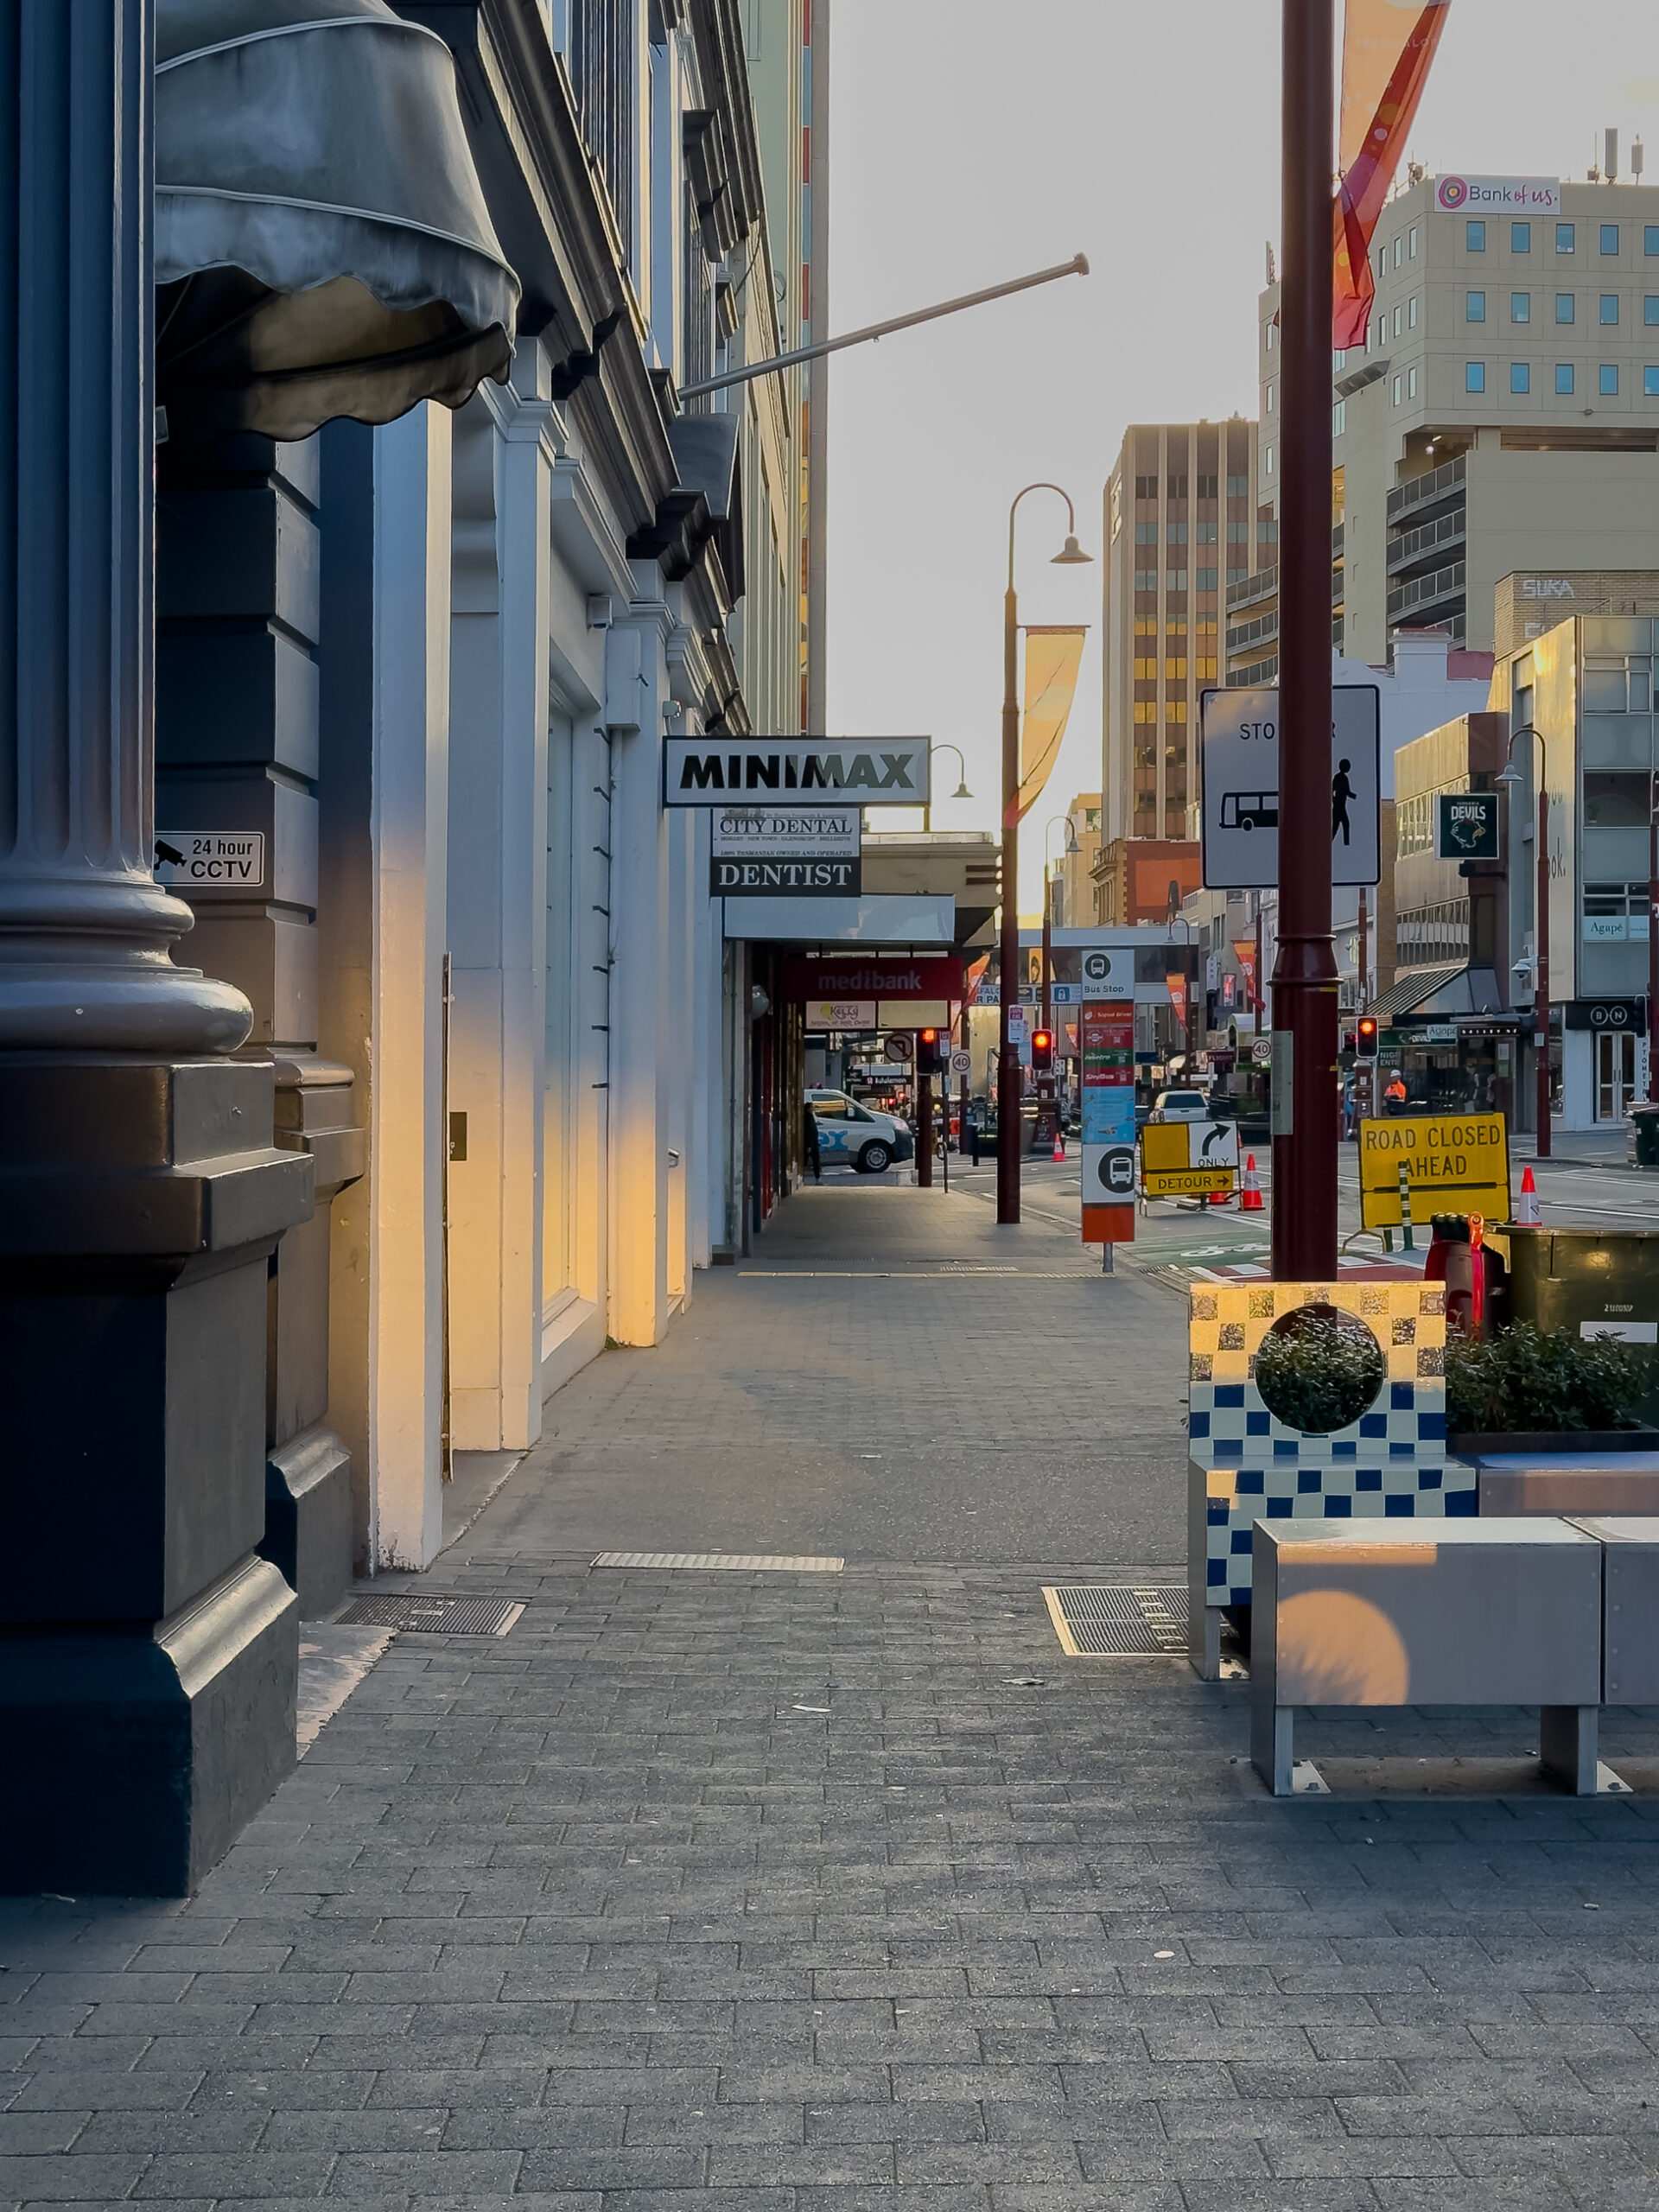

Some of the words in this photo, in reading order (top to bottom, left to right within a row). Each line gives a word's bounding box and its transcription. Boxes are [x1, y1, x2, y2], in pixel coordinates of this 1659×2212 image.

[1470, 186, 1511, 201] Bank
[1515, 184, 1528, 205] of
[1239, 722, 1276, 741] STO
[679, 753, 915, 789] MINIMAX
[1452, 806, 1486, 820] DEVILS
[720, 819, 766, 833] CITY
[771, 819, 853, 833] DENTAL
[193, 839, 212, 855] 24
[218, 839, 253, 855] hour
[191, 861, 252, 878] CCTV
[719, 865, 852, 885] DENTIST
[1591, 922, 1624, 935] Agapé
[818, 970, 922, 989] medibank
[1255, 1045, 1268, 1053] 40
[956, 1058, 968, 1067] 40
[1366, 1128, 1416, 1150] ROAD
[1427, 1125, 1500, 1147] CLOSED
[1198, 1158, 1229, 1167] ONLY
[1406, 1155, 1467, 1177] AHEAD
[1158, 1177, 1211, 1190] DETOUR
